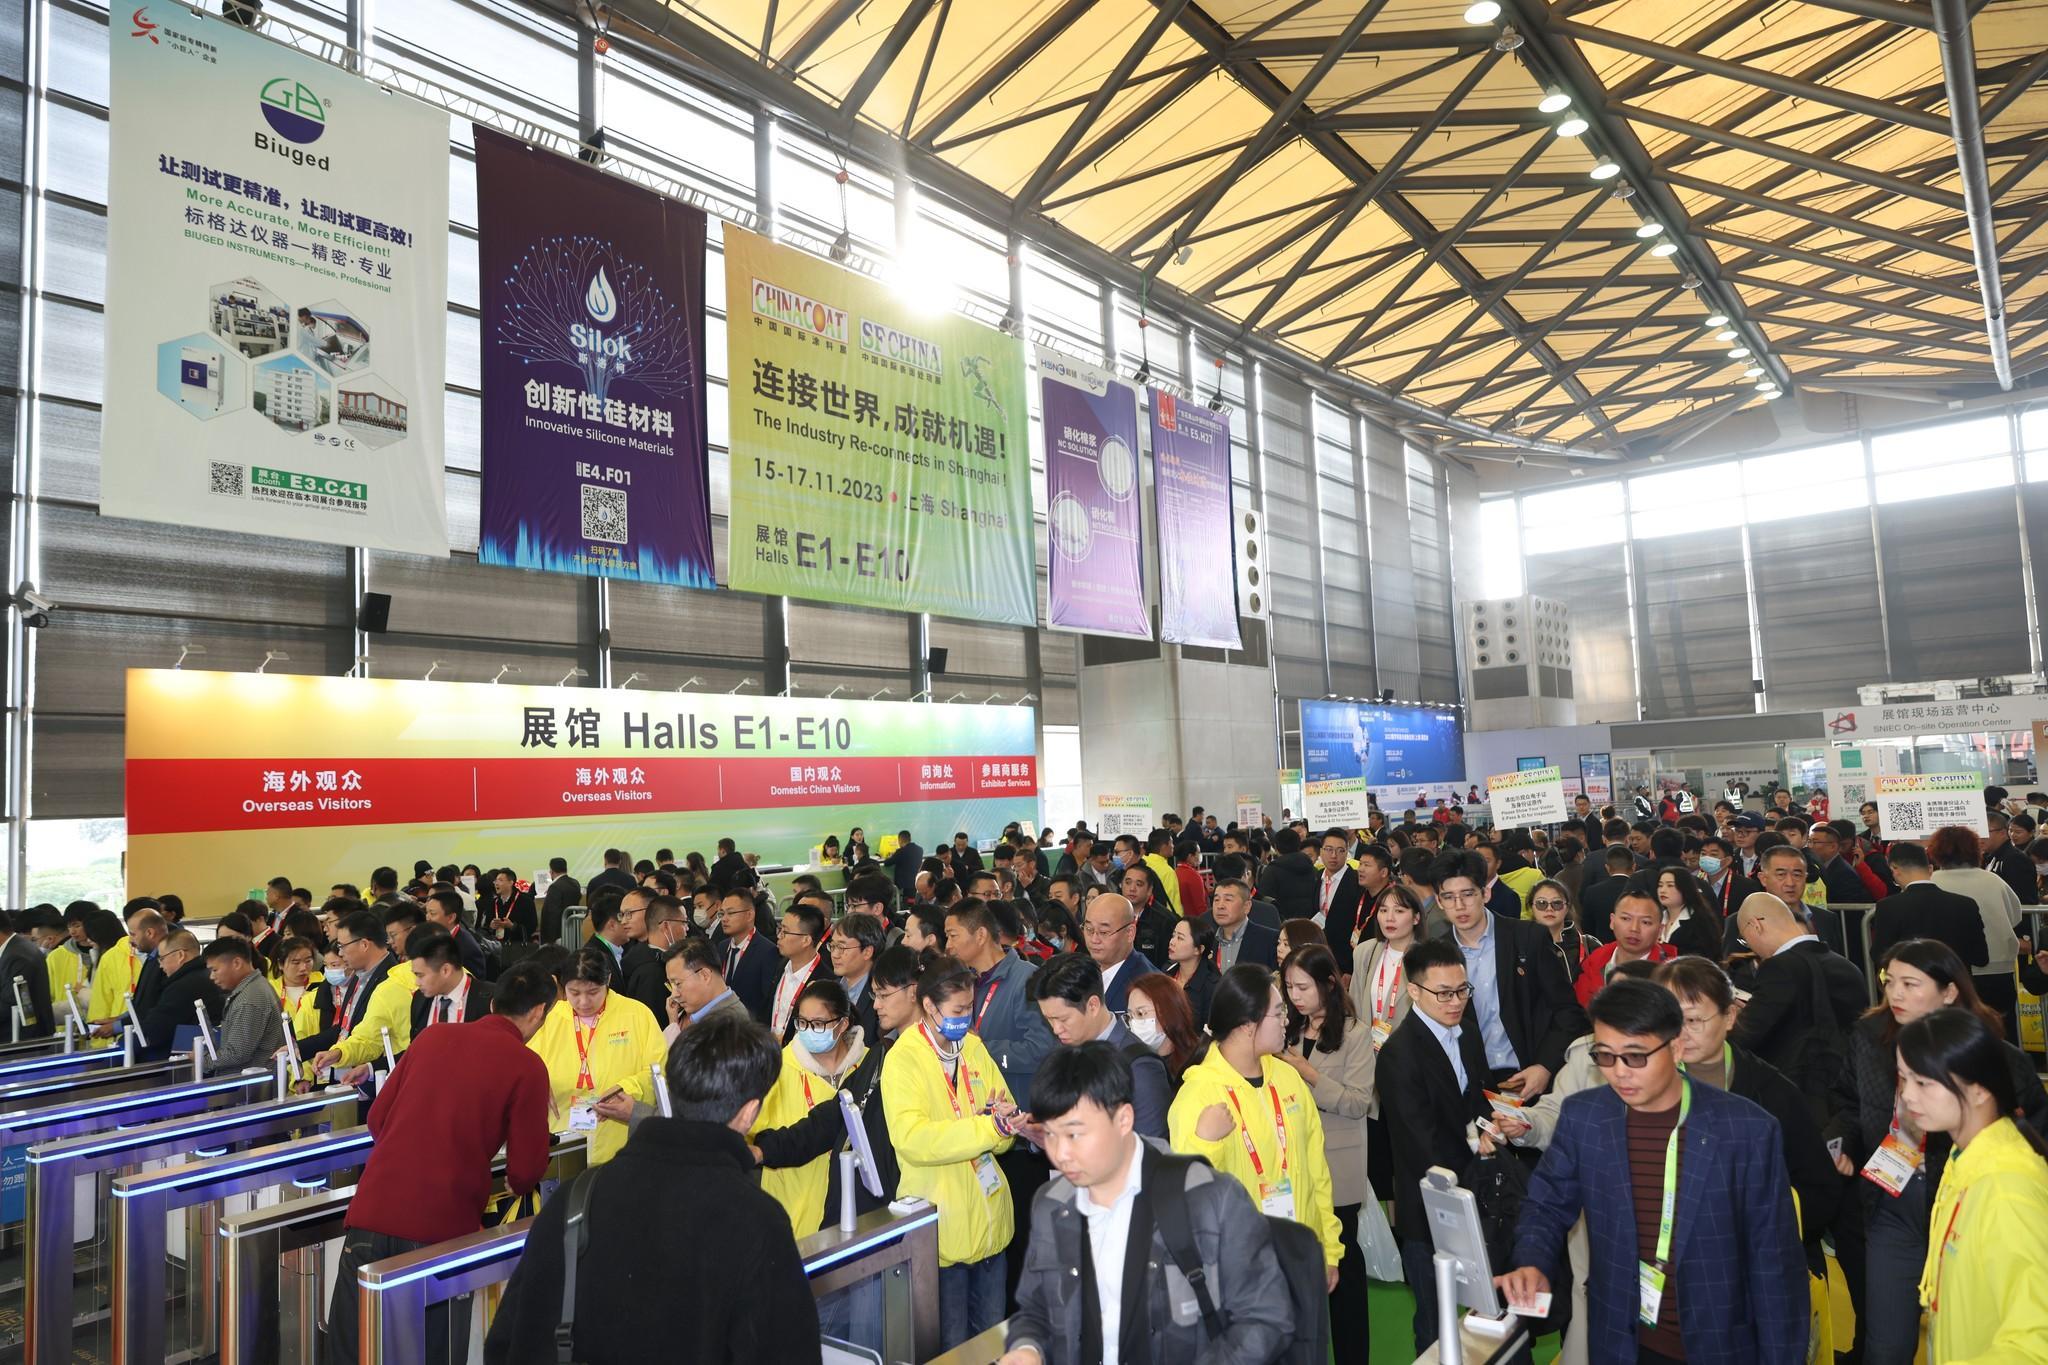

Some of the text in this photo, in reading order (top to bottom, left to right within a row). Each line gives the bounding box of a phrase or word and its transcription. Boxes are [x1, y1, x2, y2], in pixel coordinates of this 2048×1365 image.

[255, 132, 329, 171] Biuged
[186, 187, 390, 258] More Accurate, More Efficient!
[184, 229, 225, 246] BIUGED
[340, 272, 391, 293] Professional
[755, 282, 846, 339] CHINACOAT
[570, 324, 632, 361] Silok
[754, 316, 847, 354] 中国国际涂料展
[888, 331, 942, 372] CHINA
[524, 378, 674, 439] 创新性硅材料
[525, 416, 674, 456] Innovative Silicone Materials
[754, 408, 781, 431] The
[786, 420, 845, 450] Industry
[850, 435, 930, 468] Re-connects
[933, 455, 946, 471] in
[948, 458, 1000, 486] Shanghai
[1058, 439, 1098, 457] NC SOLUTION
[258, 477, 280, 486] Booth
[582, 462, 631, 485] E4.F01
[754, 457, 883, 503] 15-17.11.2023
[290, 474, 362, 498] E3.C41
[252, 486, 368, 510] 热烈欢迎莅临本司展台参观指导
[904, 492, 1009, 529] 上海 Shanghai
[755, 524, 788, 547] 展馆
[755, 545, 789, 566] Halls
[1882, 702, 2000, 721] 展馆现场运营中心
[520, 706, 851, 750] 展馆 Halls E1-E10
[1873, 717, 2012, 734] SNIEC On-site Operation Center
[263, 769, 363, 793] 海外观众
[575, 766, 646, 786] 海外观众
[790, 766, 842, 783] 国内观众
[921, 764, 953, 779] 问询处
[981, 763, 1029, 778] 参展商服务
[770, 784, 861, 796] Domestic China Visitors
[920, 780, 956, 791] Information
[981, 779, 1031, 788] Exhibitor Services
[242, 797, 372, 813] Overseas Visitors
[562, 789, 653, 803] Overseas Visitors
